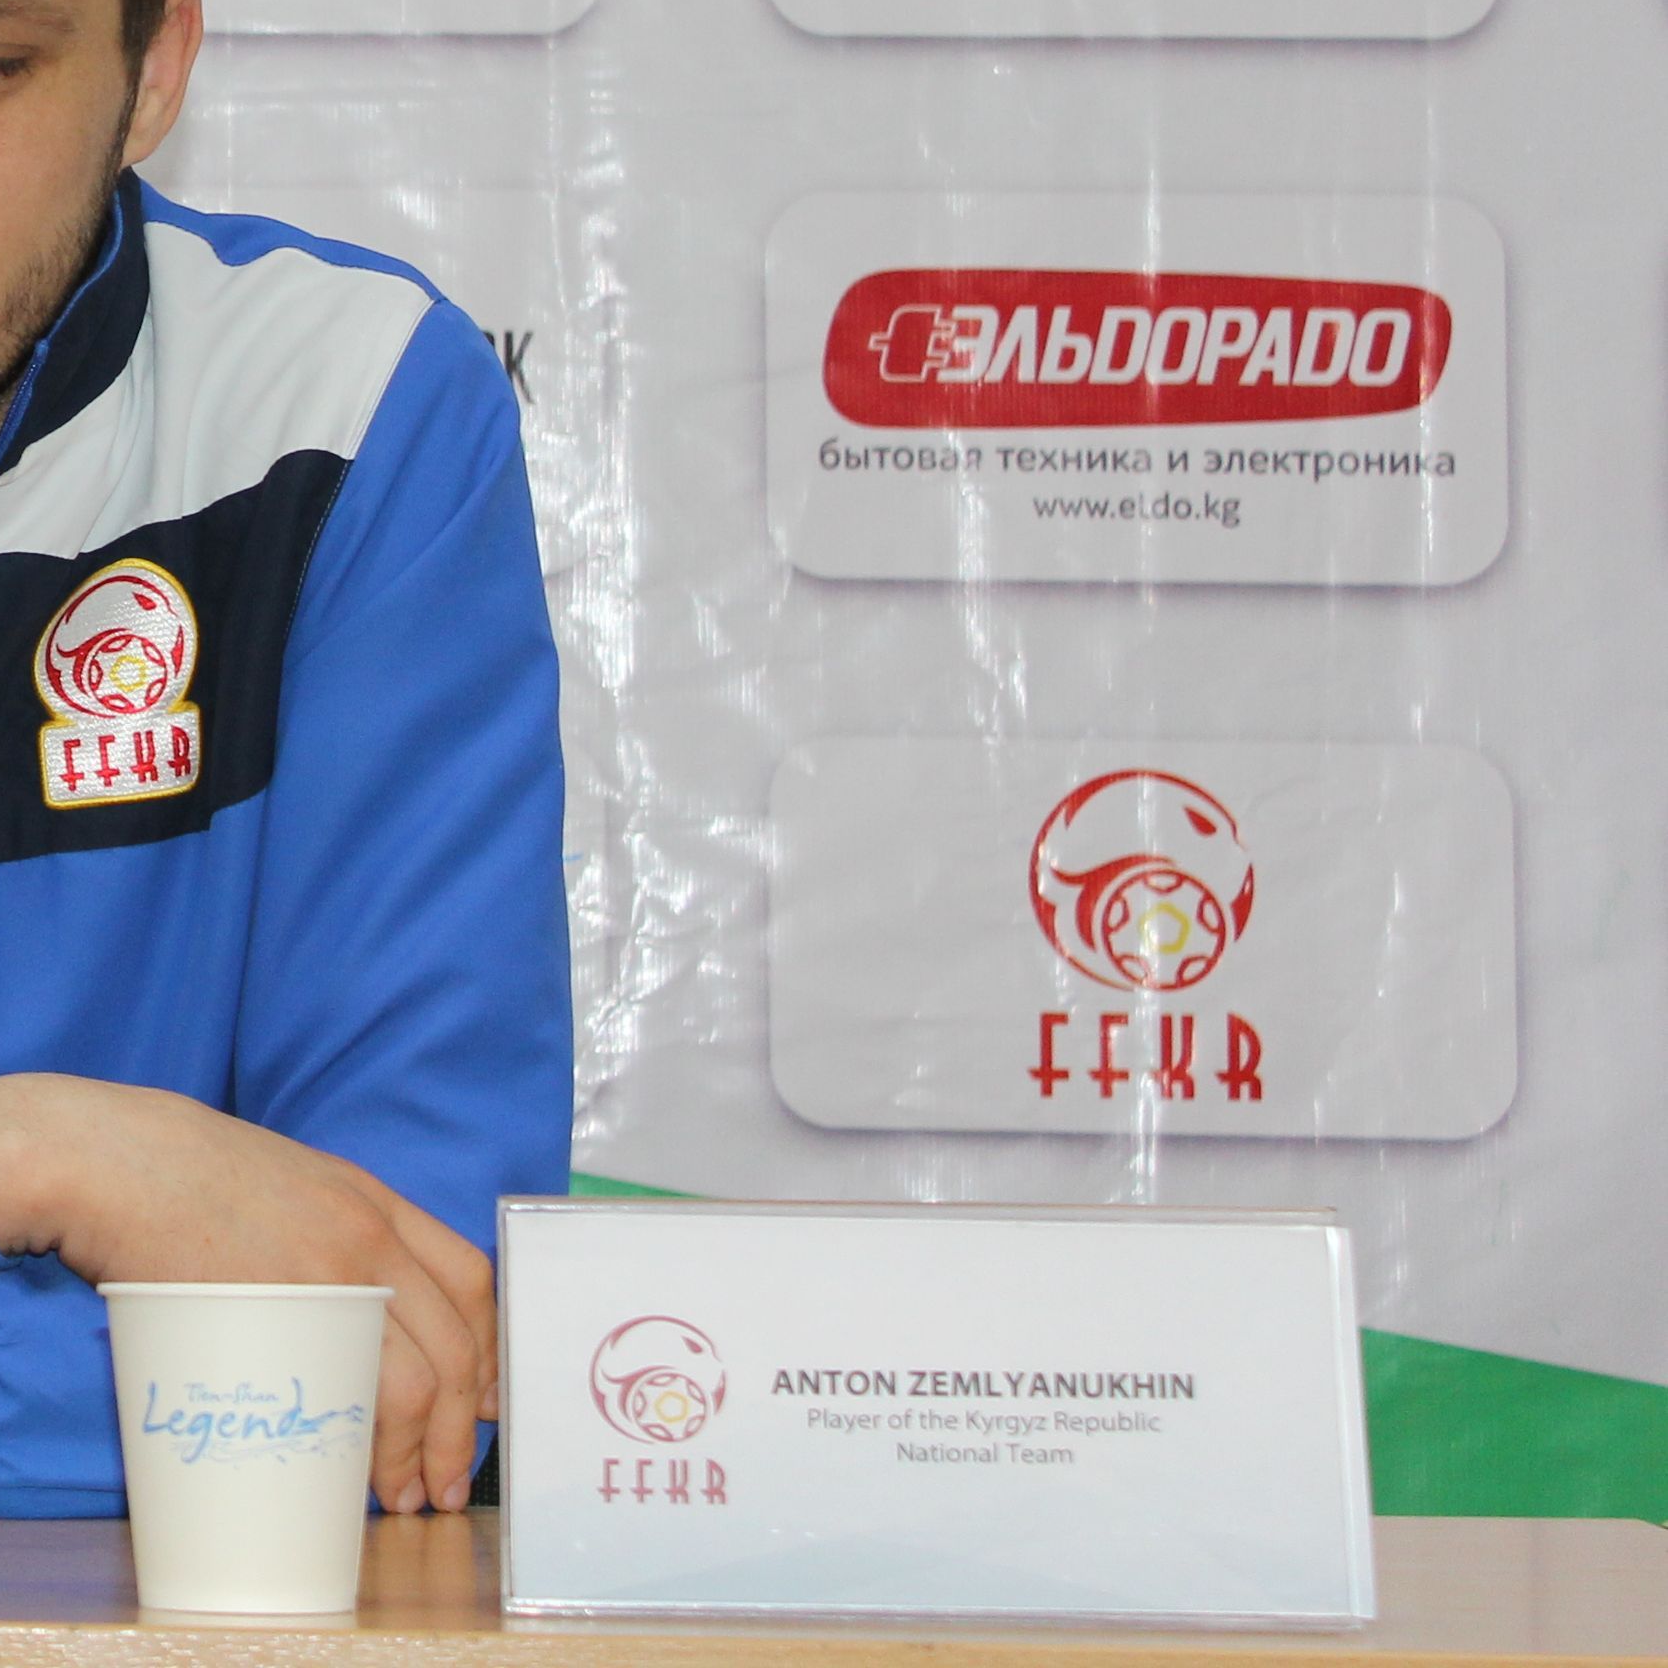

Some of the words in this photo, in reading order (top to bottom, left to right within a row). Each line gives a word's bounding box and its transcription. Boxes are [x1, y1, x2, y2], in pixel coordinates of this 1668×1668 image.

[818, 437, 983, 472] бытовая
[995, 448, 1152, 474] техника
[1167, 449, 1190, 474] и
[1203, 449, 1456, 482] электроника
[1032, 491, 1241, 529] www.eldo.kg
[59, 724, 192, 792] FFKR
[1029, 1011, 1264, 1101] FFKR
[771, 1369, 897, 1397] ANTON
[907, 1370, 1195, 1400] ZEMLYANUKHIN
[142, 1376, 302, 1464] Legend
[807, 1407, 882, 1435] Player
[887, 1407, 913, 1431] of
[918, 1408, 960, 1432] the
[965, 1409, 1049, 1437] Kyrgyz
[1053, 1409, 1162, 1438] Republic
[896, 1441, 1000, 1464] National
[1004, 1442, 1075, 1465] Team
[597, 1457, 728, 1505] FFKR
